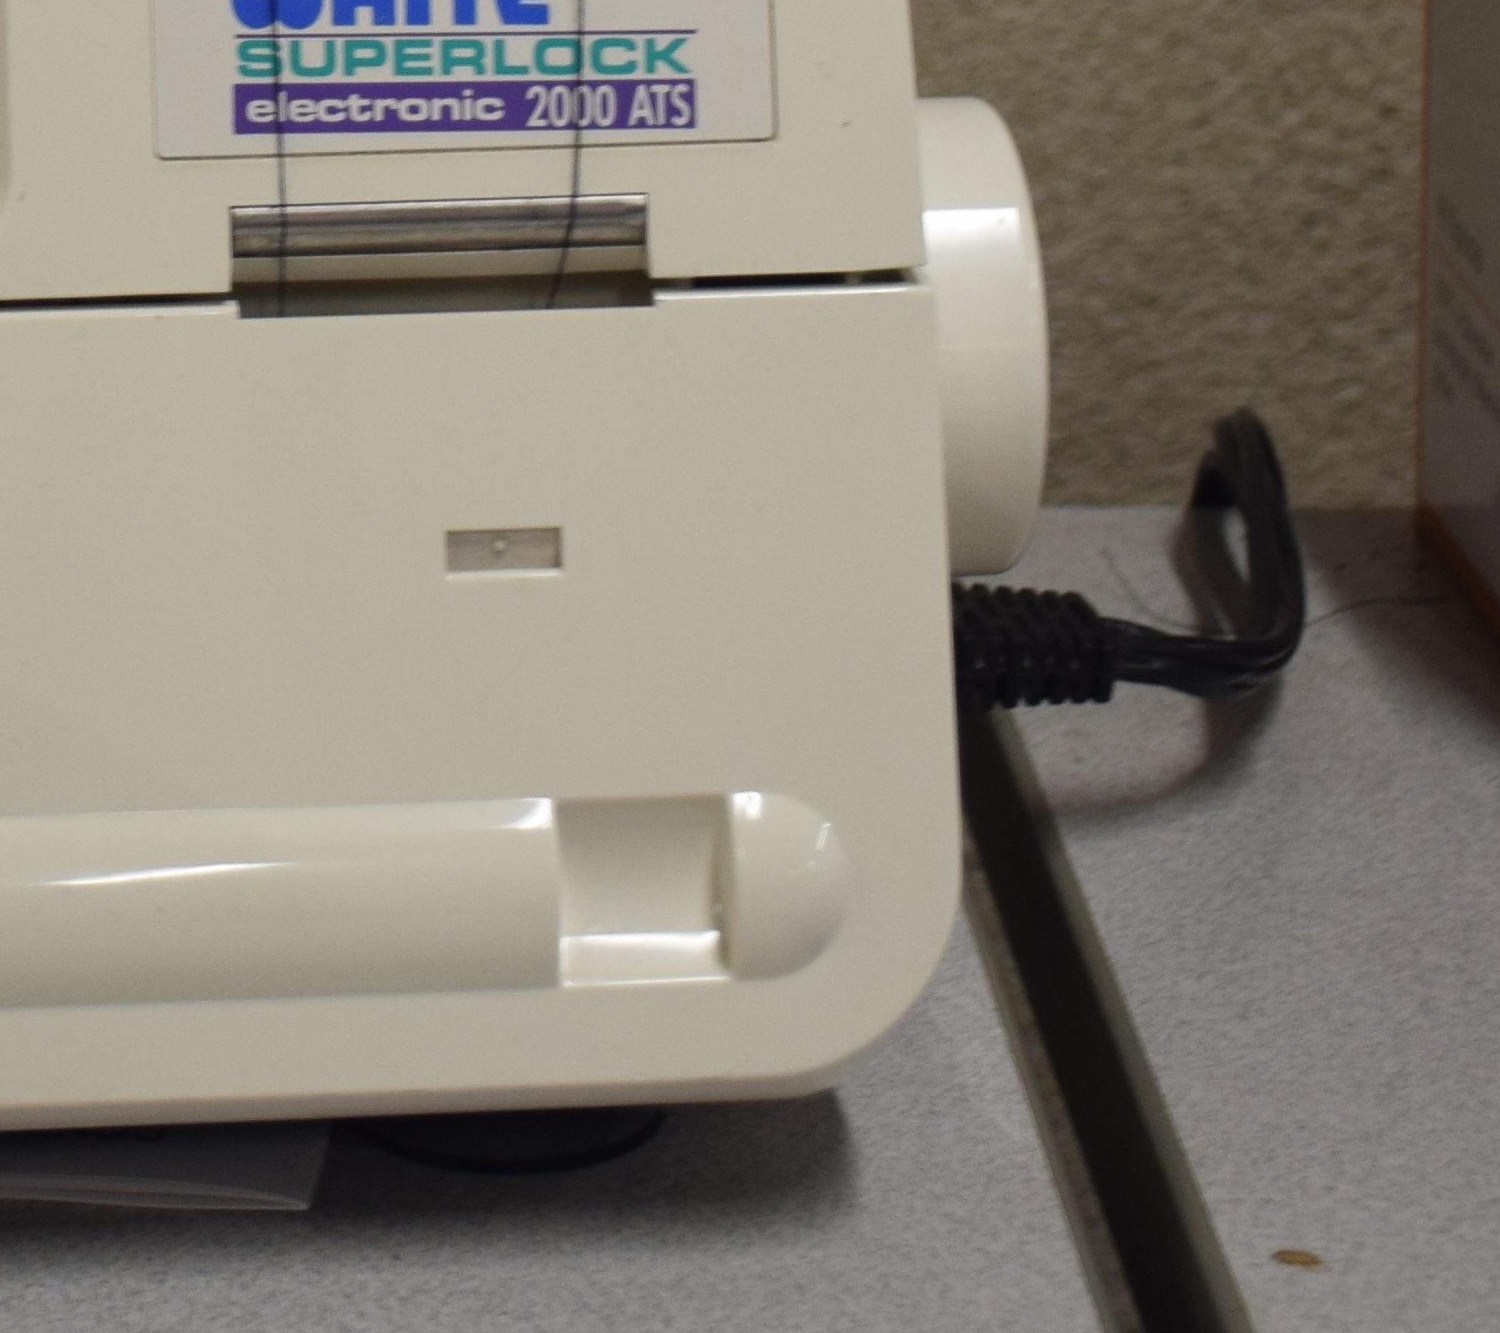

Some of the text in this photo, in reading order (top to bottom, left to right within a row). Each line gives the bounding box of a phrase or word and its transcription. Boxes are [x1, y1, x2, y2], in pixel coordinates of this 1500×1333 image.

[236, 36, 691, 78] SUPERLOCK
[244, 84, 691, 128] electronic 2000 ATS
